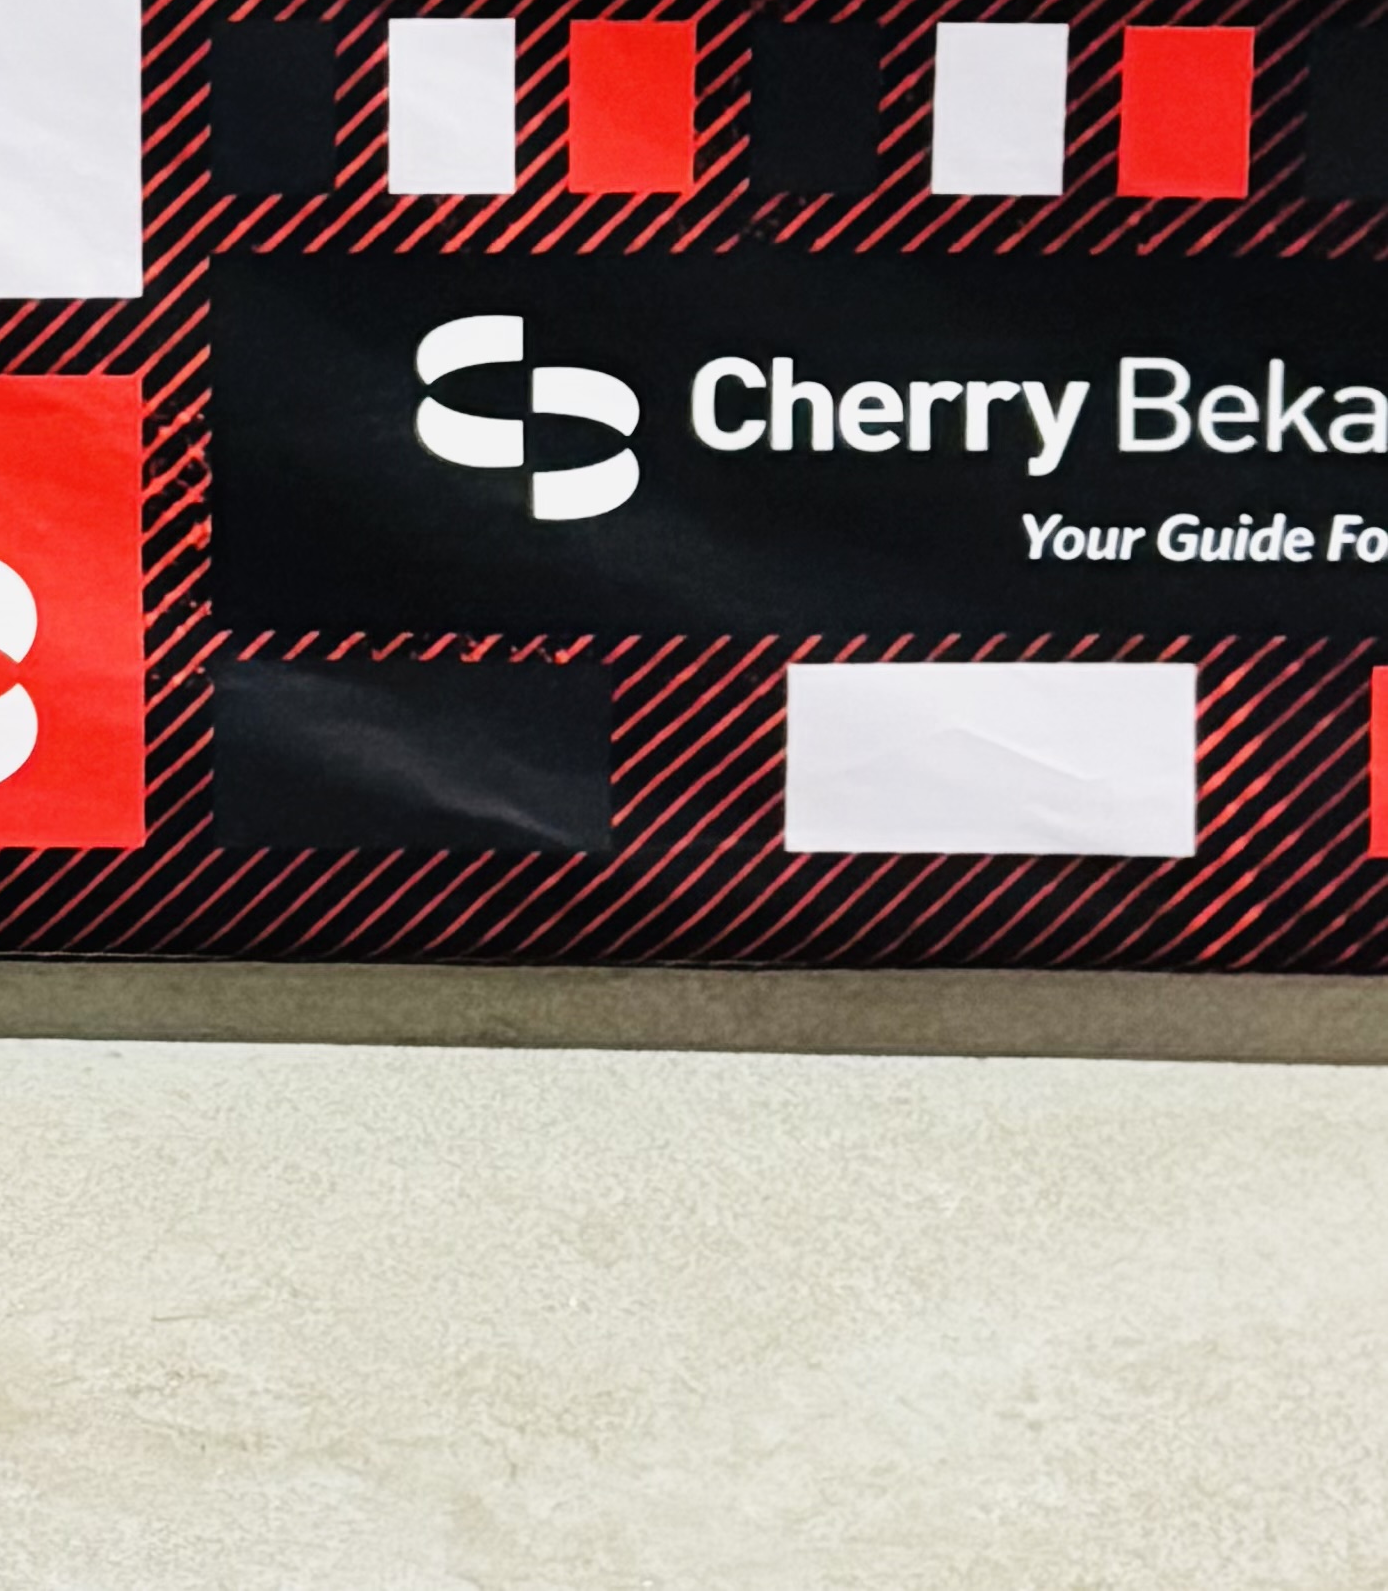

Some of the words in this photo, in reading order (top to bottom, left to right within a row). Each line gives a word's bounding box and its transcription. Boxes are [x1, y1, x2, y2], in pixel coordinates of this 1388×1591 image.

[691, 356, 1091, 477] Cherry
[1022, 513, 1146, 561] Your
[1156, 512, 1315, 563] Guide
